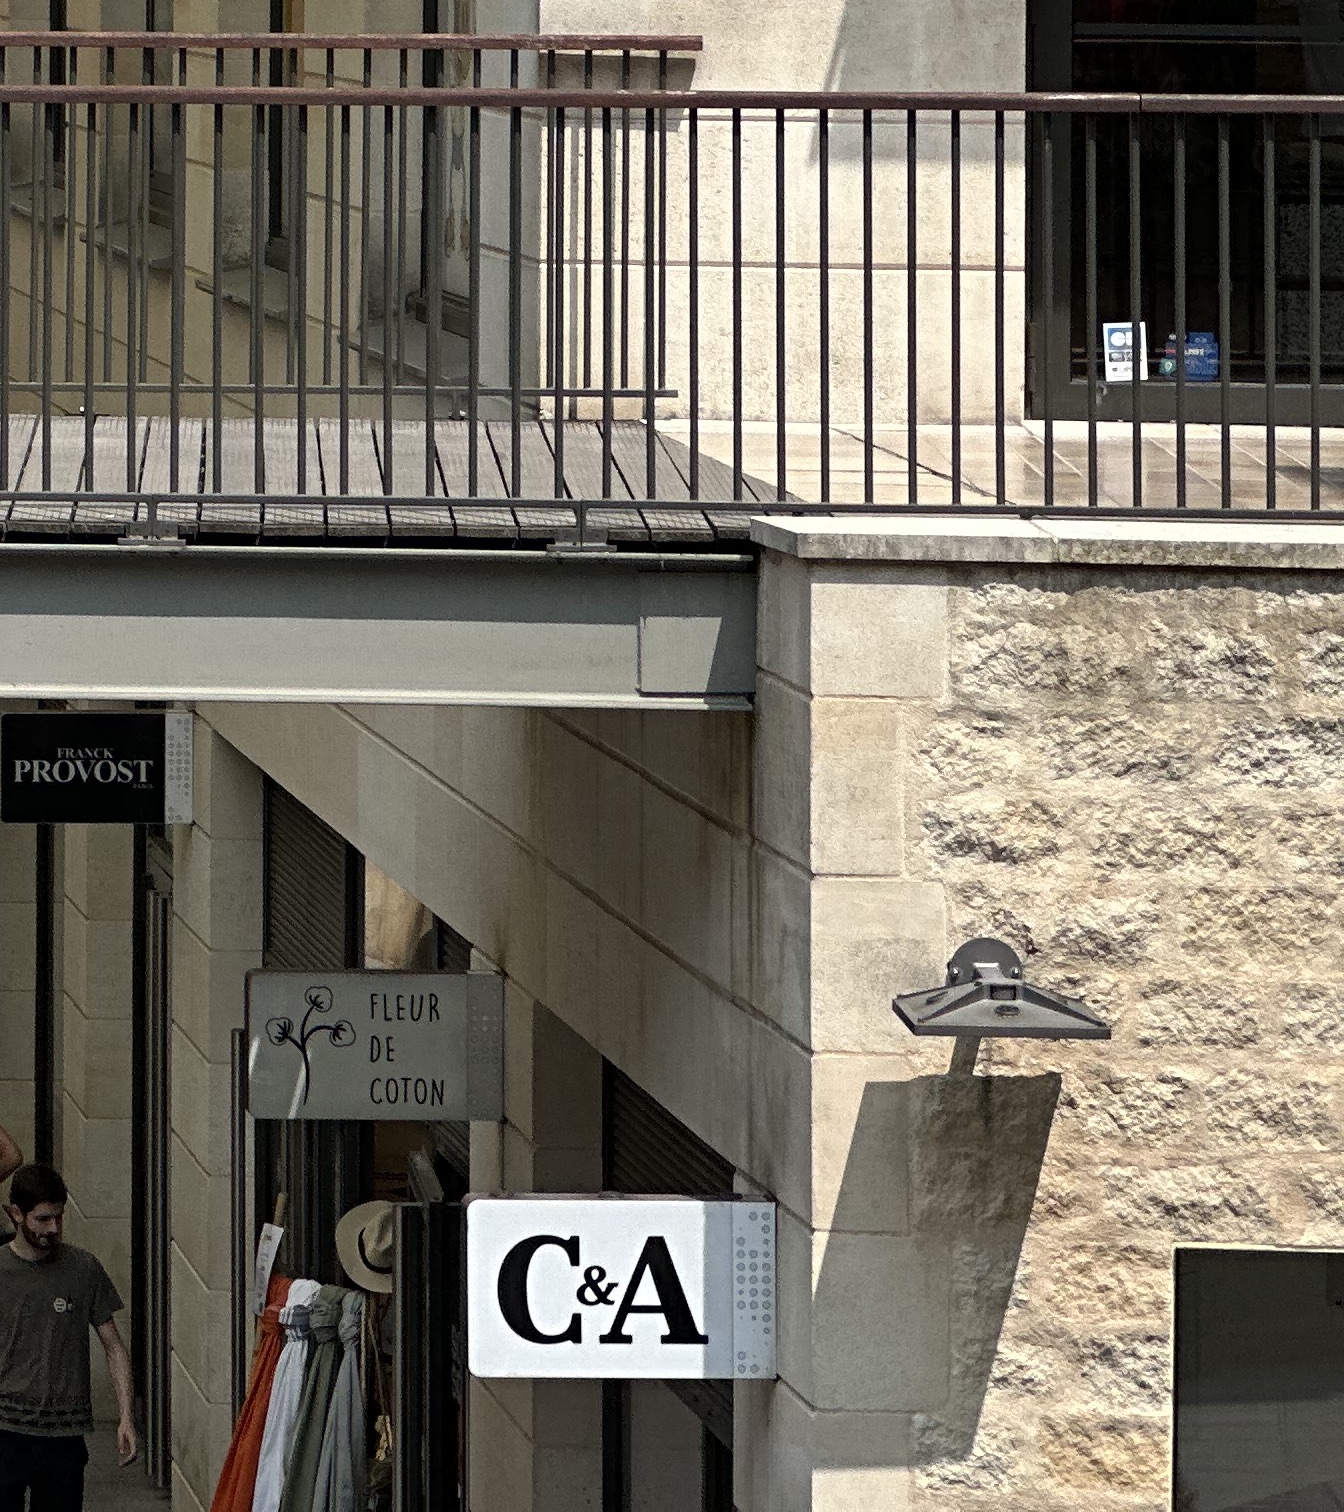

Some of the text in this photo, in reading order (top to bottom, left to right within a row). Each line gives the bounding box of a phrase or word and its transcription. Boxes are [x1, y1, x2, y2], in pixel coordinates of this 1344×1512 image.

[57, 747, 114, 759] FRANCK
[13, 759, 154, 783] PROVOST
[368, 991, 441, 1022] FLEUR
[368, 1034, 396, 1063] DE
[368, 1077, 446, 1107] COTON
[497, 1234, 709, 1346] C&A
